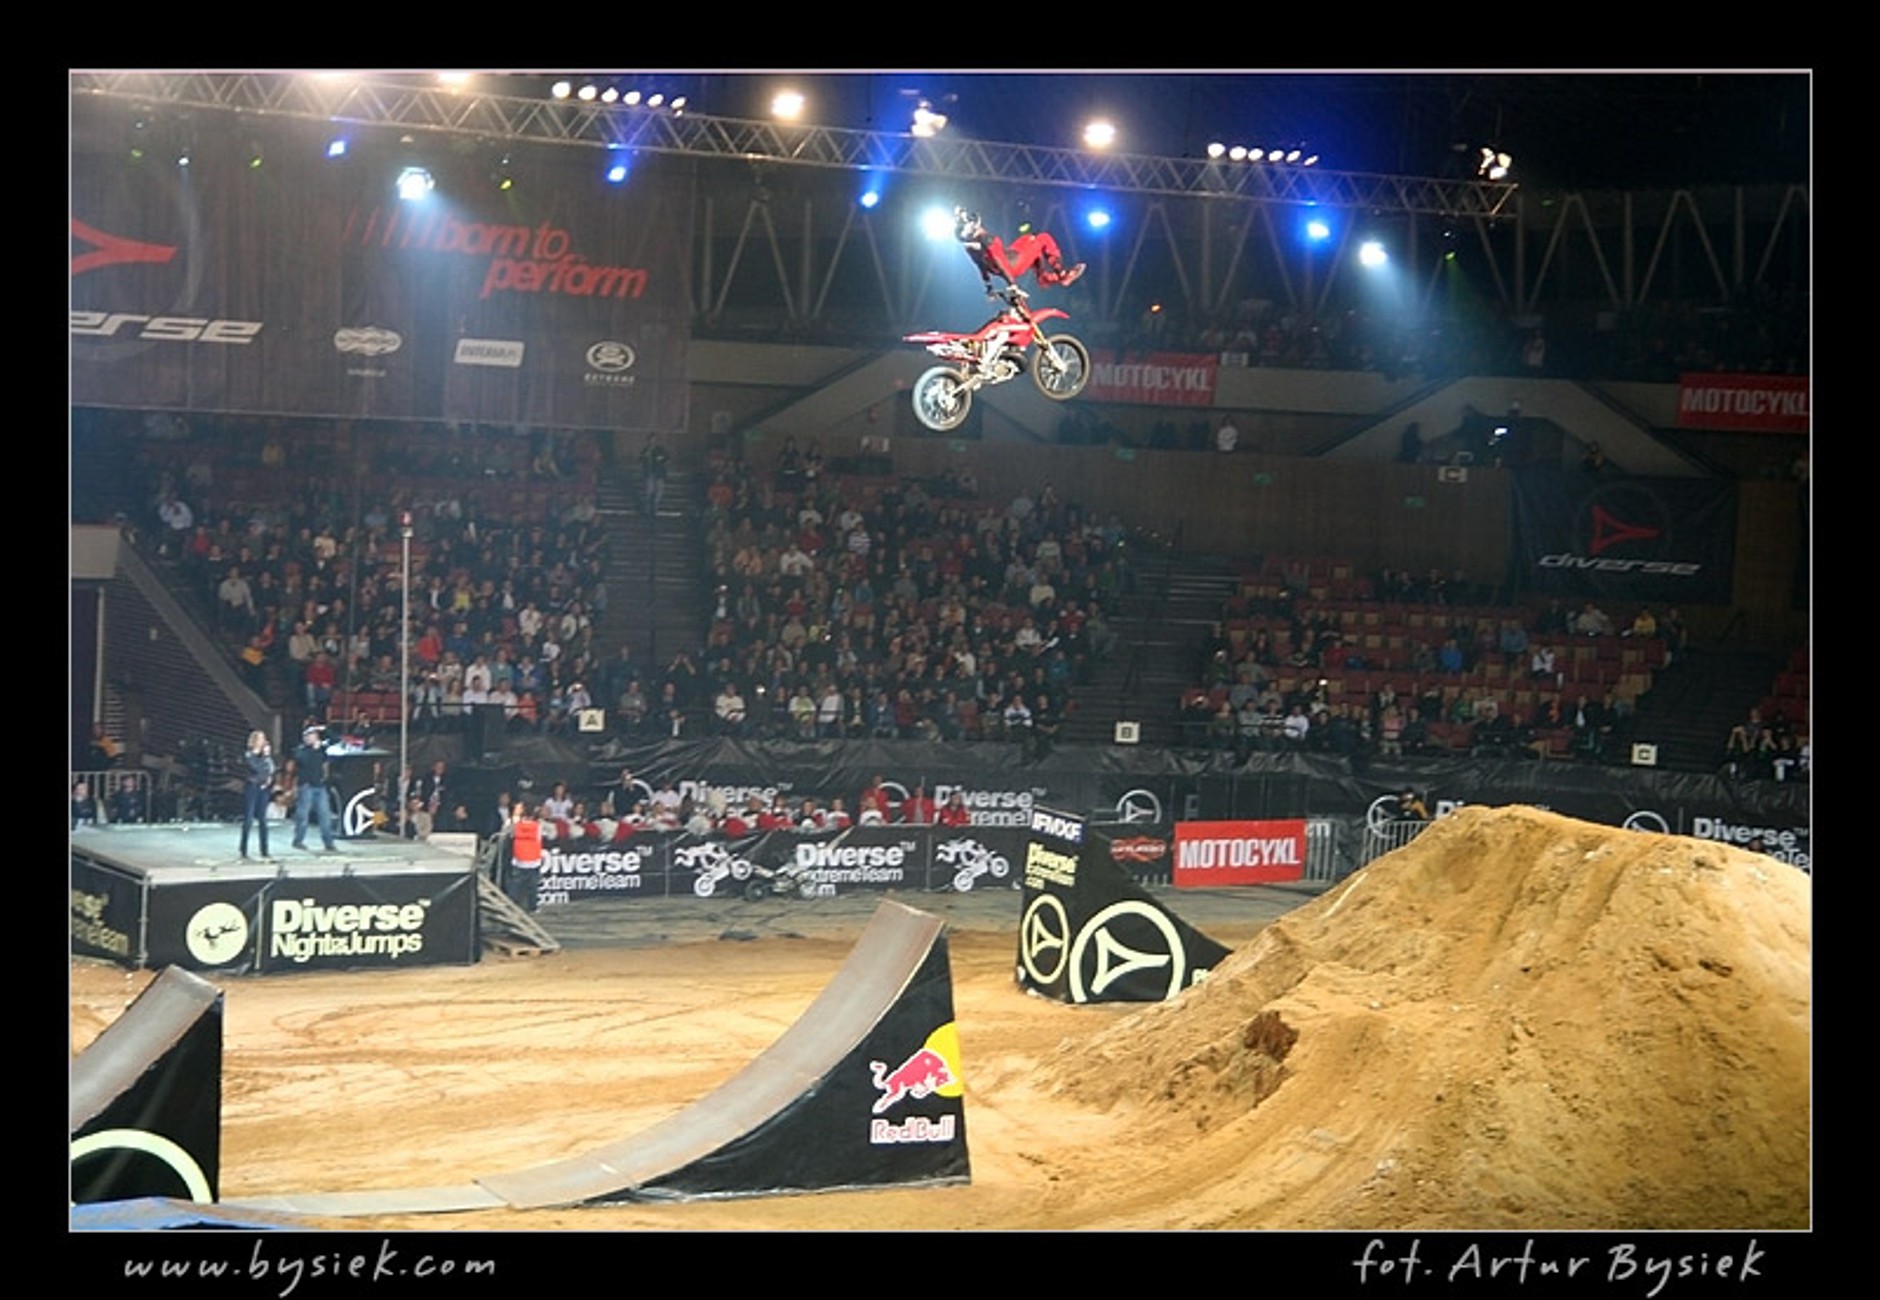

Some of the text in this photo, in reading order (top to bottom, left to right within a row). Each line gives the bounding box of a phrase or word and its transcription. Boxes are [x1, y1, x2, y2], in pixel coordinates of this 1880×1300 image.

[436, 213, 570, 258] born to
[480, 252, 648, 299] perform
[1091, 362, 1212, 393] MOTOCYKL
[1681, 387, 1808, 416] MOTOCYKL
[1539, 552, 1701, 576] diverse
[796, 842, 905, 867] Diverse
[1178, 838, 1301, 869] MOTOCYKL
[273, 898, 425, 932] Diverse
